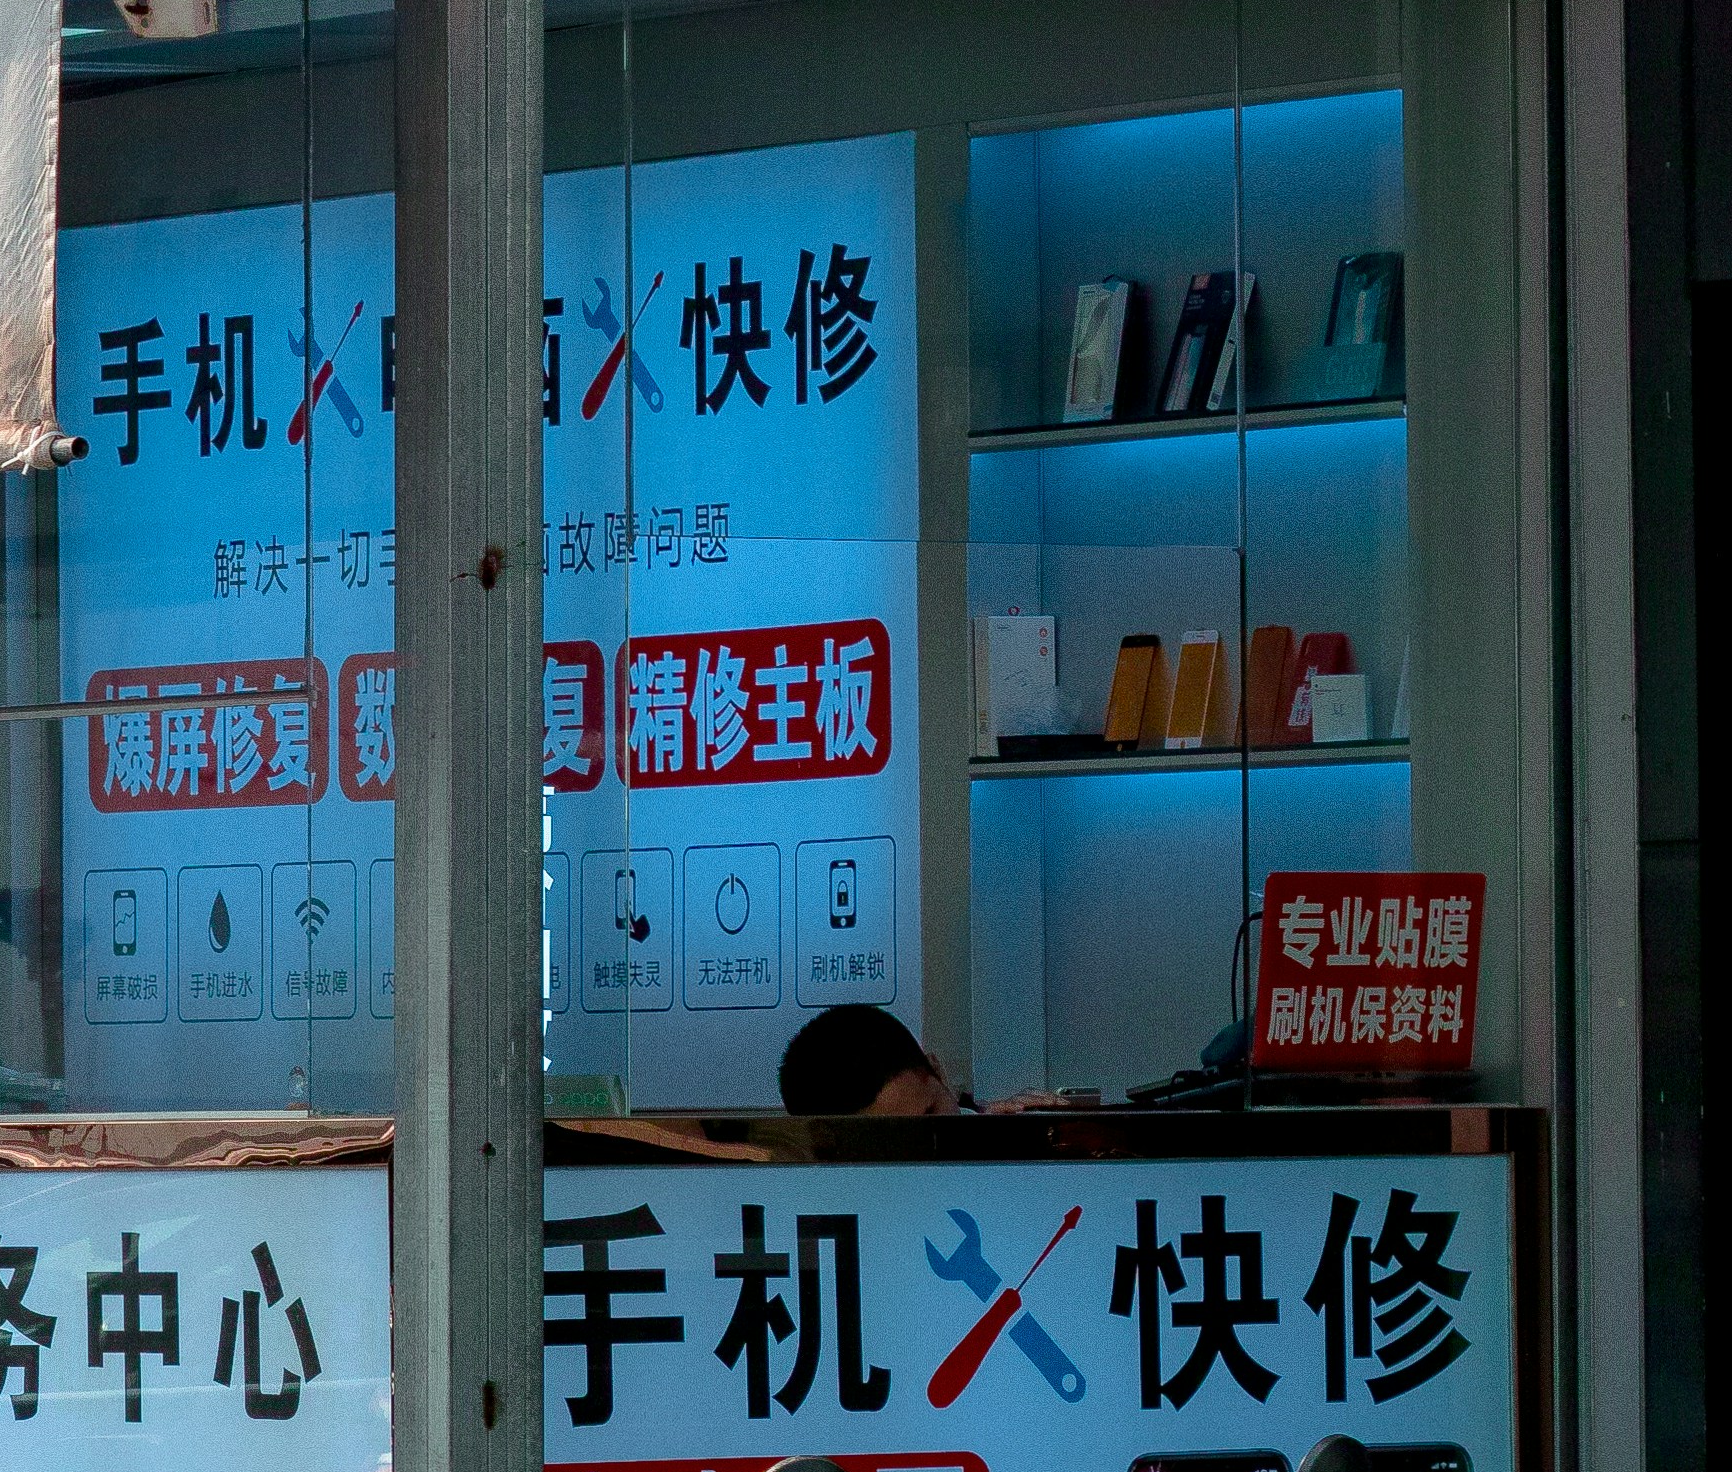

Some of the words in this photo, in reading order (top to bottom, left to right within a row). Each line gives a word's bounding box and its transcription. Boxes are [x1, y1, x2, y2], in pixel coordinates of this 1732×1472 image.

[93, 312, 266, 465] 手机
[680, 243, 878, 416] 快修
[102, 673, 316, 799] 爆屏修复
[629, 636, 879, 773] 精修主板
[1277, 893, 1469, 972] 专业贴膜
[285, 969, 349, 998] 信号故障
[593, 960, 662, 989] 触摸失灵
[697, 956, 771, 987] 无法开机
[810, 951, 886, 984] 刷机解锁
[95, 974, 159, 1002] 屏幕破损
[190, 971, 254, 1000] 手机进水
[1267, 983, 1466, 1048] 刷机保资料
[544, 1200, 892, 1427] 手机
[1108, 1188, 1472, 1410] 快修
